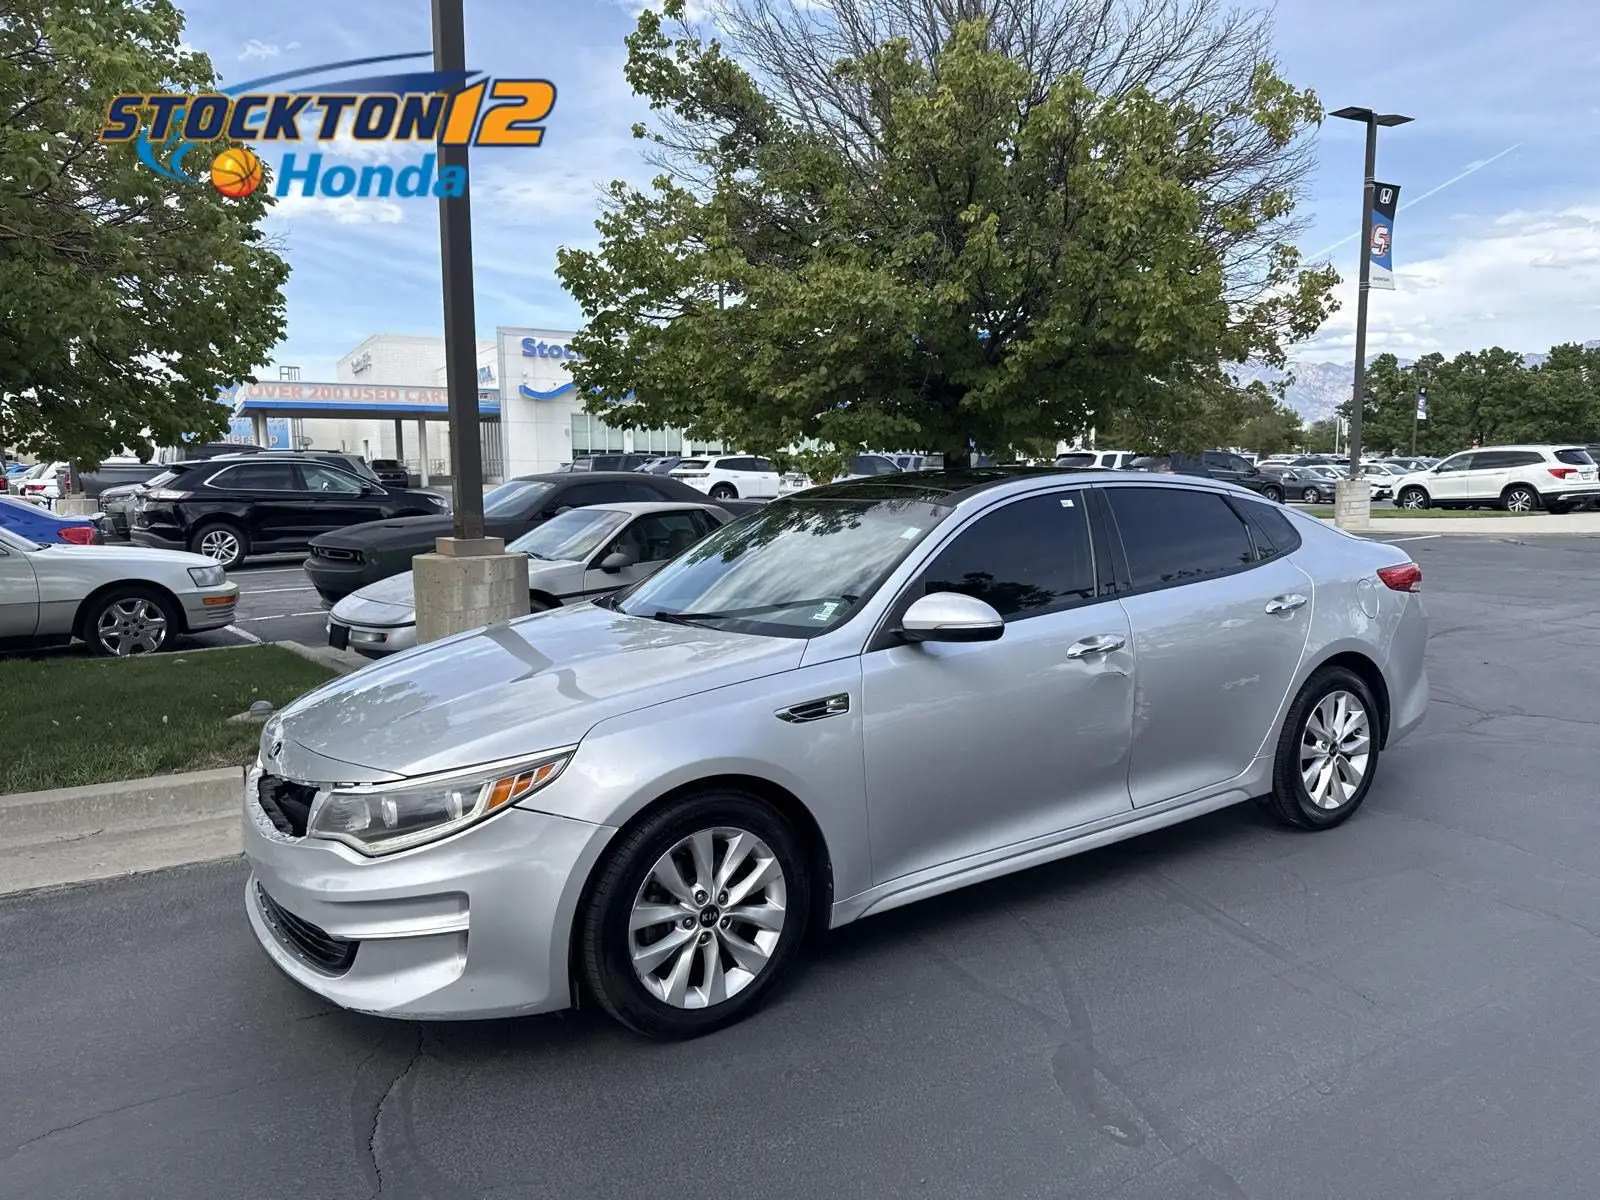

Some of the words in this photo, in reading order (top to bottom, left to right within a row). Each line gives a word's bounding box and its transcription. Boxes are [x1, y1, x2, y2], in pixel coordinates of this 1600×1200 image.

[248, 385, 303, 398] OVER
[309, 386, 344, 400] 200
[351, 387, 399, 401] USED
[701, 911, 718, 922] KIA
